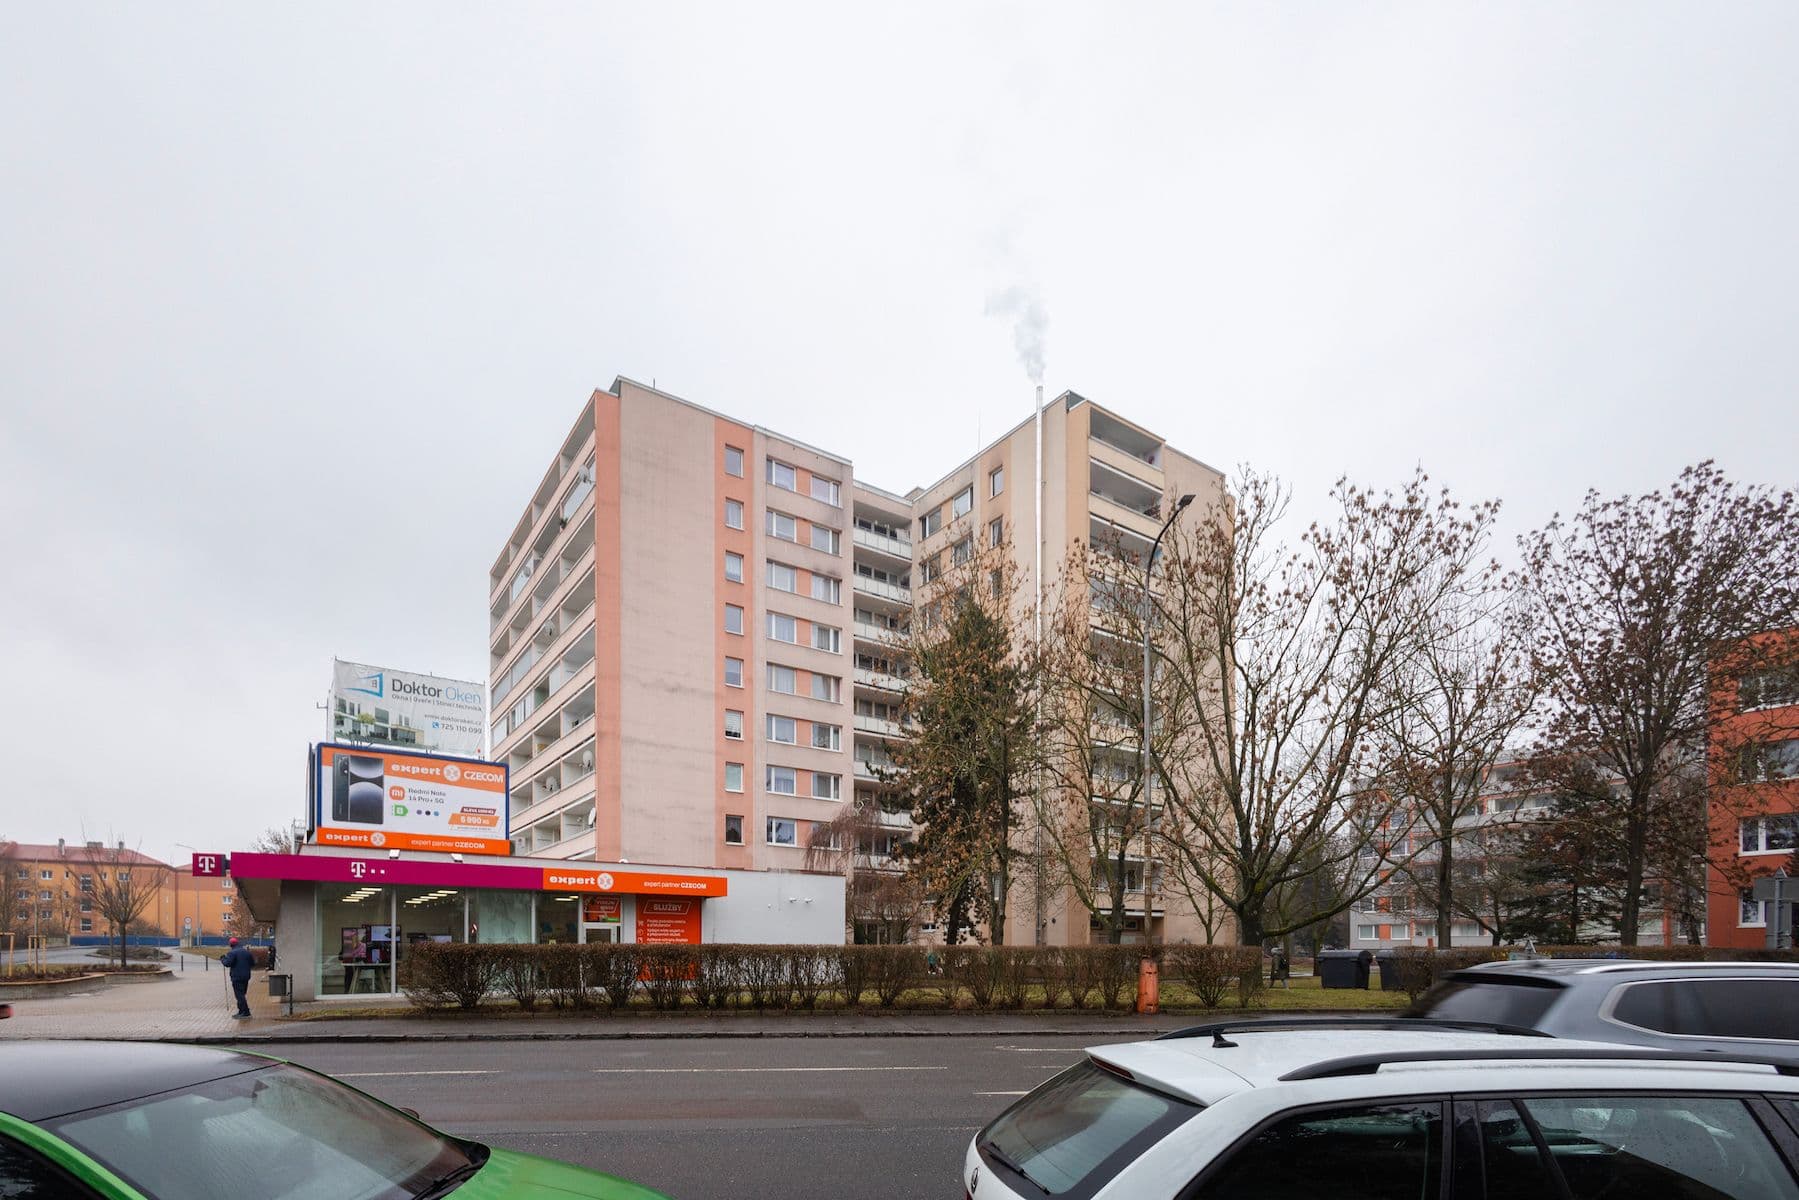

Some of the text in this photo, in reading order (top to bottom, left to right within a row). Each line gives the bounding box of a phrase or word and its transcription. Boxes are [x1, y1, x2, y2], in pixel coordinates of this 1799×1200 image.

[391, 678, 481, 705] Doktor Oken
[441, 723, 455, 731] 725
[456, 725, 467, 733] 110
[391, 763, 504, 783] expert CZECOM
[408, 788, 430, 796] Redmi
[325, 834, 369, 842] expert
[431, 840, 454, 848] partner
[454, 841, 485, 849] CZECOM
[198, 856, 216, 873] T
[549, 876, 596, 886] expert
[680, 881, 707, 889] CZECOM
[653, 902, 683, 912] SLUŽBY
